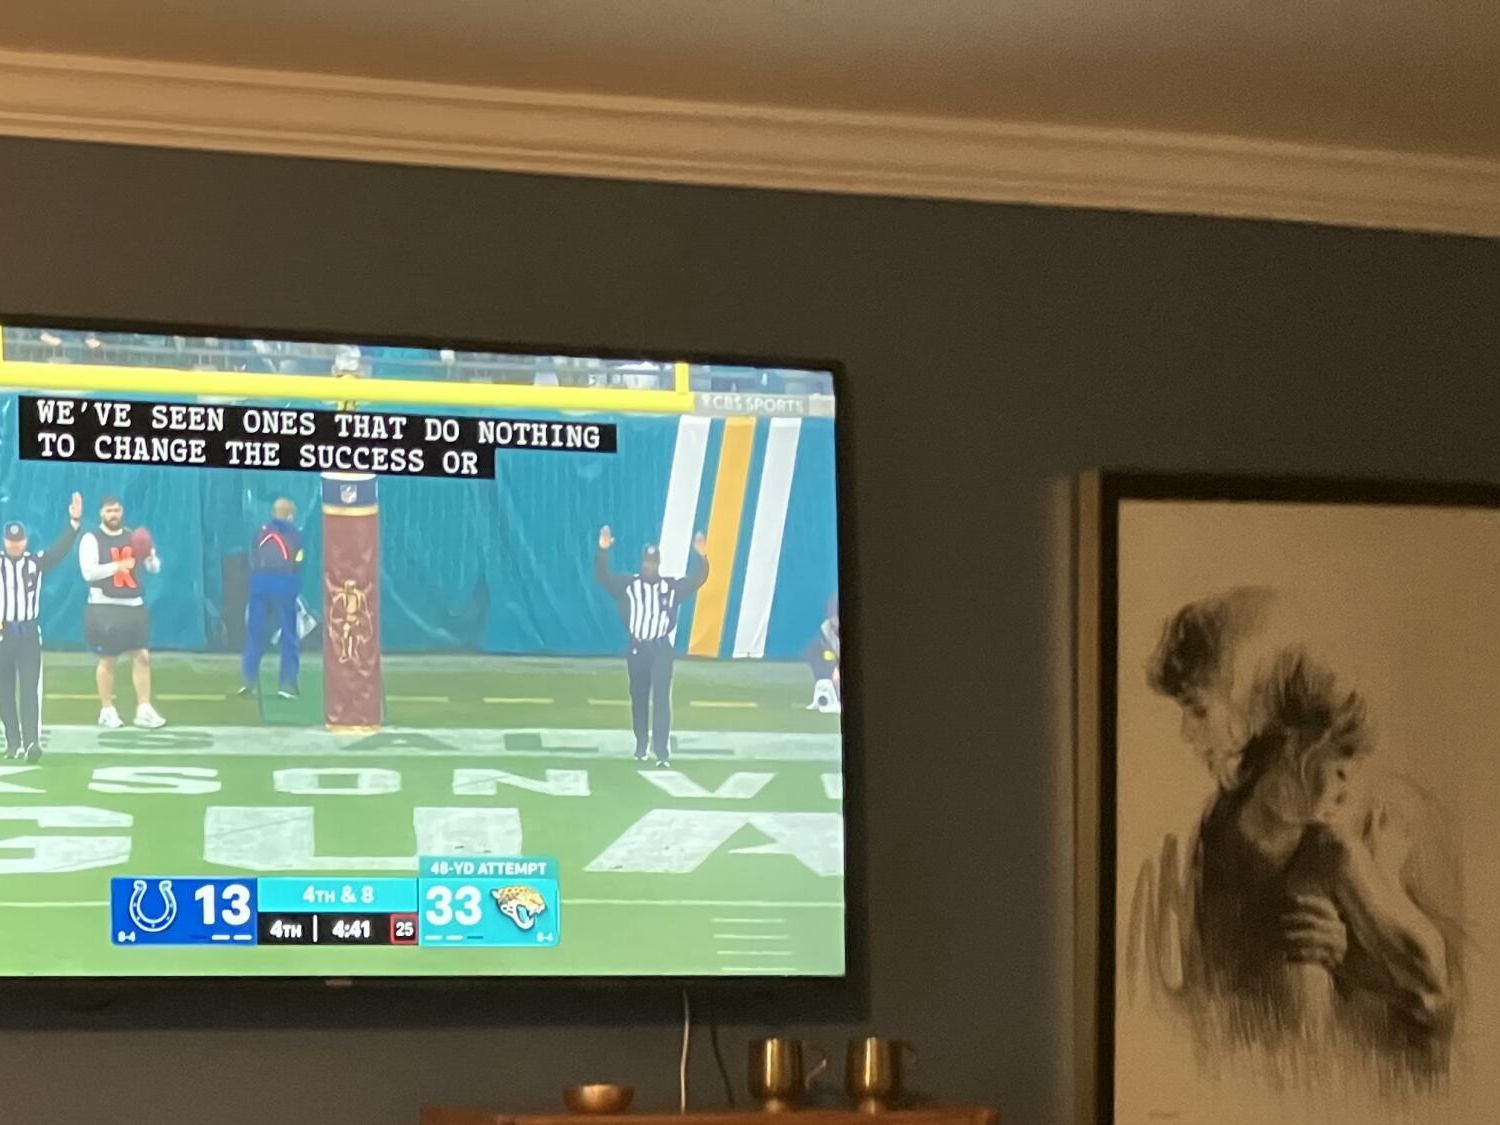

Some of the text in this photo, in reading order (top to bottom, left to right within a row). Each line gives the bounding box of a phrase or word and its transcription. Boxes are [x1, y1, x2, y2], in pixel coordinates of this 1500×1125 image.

[37, 399, 601, 449] WE'VE SEEN ONES THAT DO NOTHING
[37, 432, 478, 475] TO CHANGE THE SUCCESS OR
[477, 862, 547, 875] ATTEMPT
[195, 884, 250, 925] 13
[303, 885, 374, 904] 4TH & 8
[426, 885, 482, 926] 33
[269, 919, 370, 938] 4TH 4:41
[395, 921, 414, 937] 25
